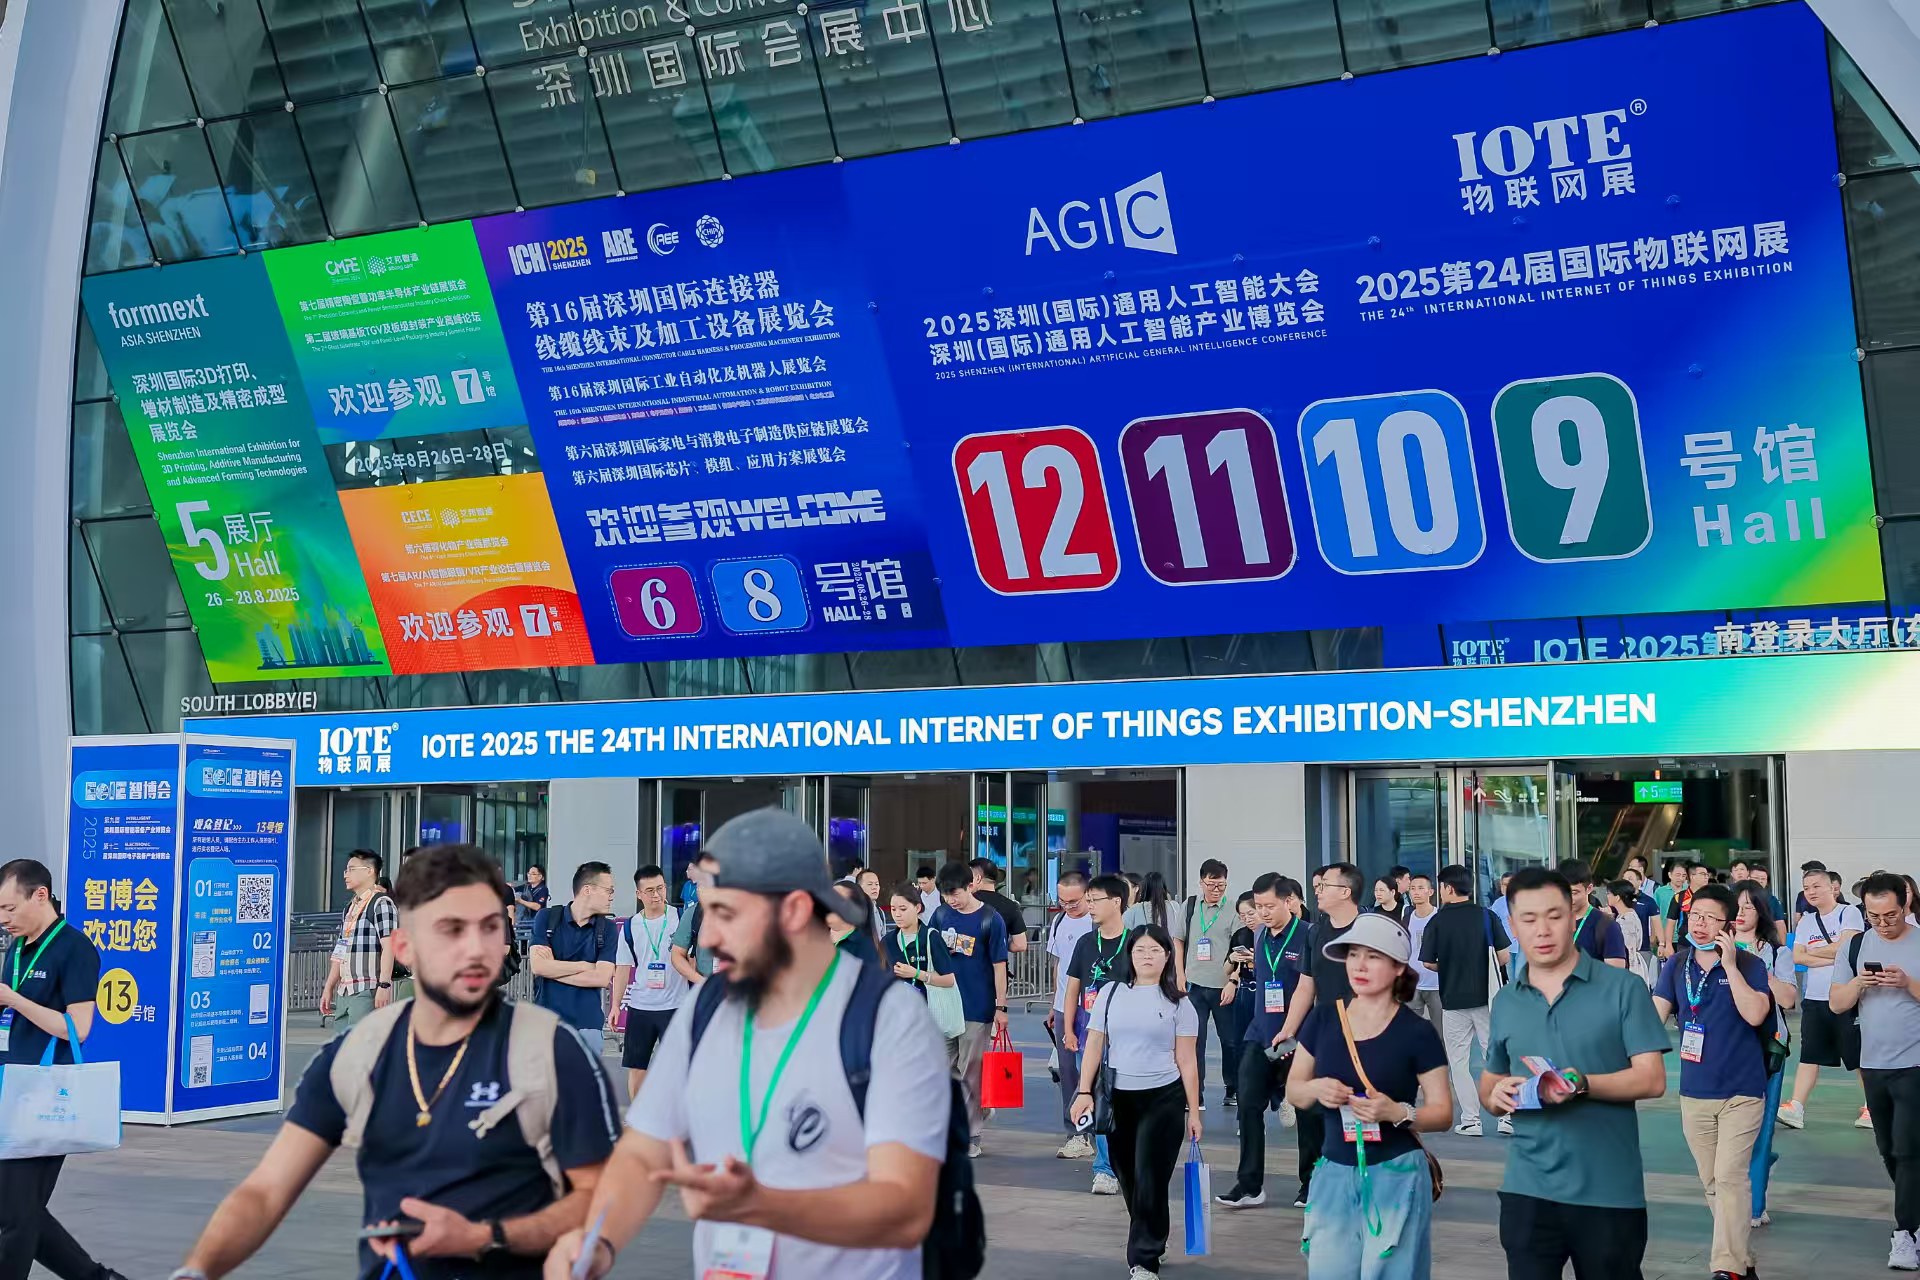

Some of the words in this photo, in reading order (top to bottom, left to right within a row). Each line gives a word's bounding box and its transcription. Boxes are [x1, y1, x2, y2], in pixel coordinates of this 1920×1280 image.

[518, 4, 658, 52] Exhibition
[531, 0, 993, 108] 深圳国际会展中心
[1461, 161, 1636, 216] 物联网展
[1025, 174, 1175, 256] AGIC
[508, 242, 546, 276] ICH
[546, 236, 588, 261] 2025
[601, 228, 638, 257] ARE
[553, 258, 592, 271] SHENZHEN
[1355, 219, 1789, 305] 2025第24届国际物联网展
[525, 269, 781, 330] 第16届深圳国际连接器
[922, 268, 1320, 338] 2025深圳(国际)通用人工智能大会
[1360, 310, 1385, 322] THE
[1390, 306, 1415, 319] 24th
[1424, 293, 1535, 315] INTERNATIONAL
[1541, 283, 1613, 301] INTERNET
[1619, 280, 1636, 291] OF
[1641, 272, 1697, 290] THINGS
[1704, 261, 1793, 283] EXHIBITION
[108, 293, 209, 329] formnext
[121, 333, 146, 348] ASIA
[146, 326, 201, 345] SHENZHEN
[534, 298, 836, 362] 线缆线束及加工设备展览会
[929, 298, 1326, 367] 深圳(国际)通用人工智能产业博览会
[935, 370, 956, 380] 2025
[958, 364, 1006, 377] SHENZHEN
[1008, 356, 1087, 374] (INTERNATIONAL)
[1089, 350, 1140, 364] ARTIFICIAL
[1143, 345, 1186, 357] GENERAL
[1189, 336, 1258, 353] INTELLIGENCE
[1261, 329, 1328, 345] CONFERENCE
[132, 362, 258, 395] 深圳国际3D打印、
[327, 374, 446, 417] 欢迎参观
[458, 372, 473, 400] 7
[548, 355, 827, 402] 第16届深圳国际工业自动化及机器人展览会
[140, 383, 288, 419] 增材制造及精密成型
[149, 420, 198, 443] 展览会
[565, 416, 869, 461] 第六届深圳国际家电与消费电子制造供应链展览会
[157, 449, 195, 461] Shenzhen
[196, 443, 247, 457] International
[248, 440, 287, 452] Exhibition
[288, 439, 300, 448] for
[161, 464, 173, 474] 3D
[209, 457, 241, 469] Additive
[242, 452, 301, 467] Manufacturing
[1680, 423, 1819, 490] 号馆
[166, 475, 181, 487] and
[182, 471, 220, 485] Advanced
[221, 469, 254, 481] Forming
[254, 465, 308, 478] Technologies
[966, 444, 1102, 580] 12
[1143, 428, 1270, 569] 11
[1312, 409, 1459, 558] 10
[1531, 395, 1610, 545] 9
[175, 500, 230, 581] 5
[223, 511, 274, 545] 展厅
[1692, 497, 1827, 548] Hall
[235, 549, 281, 578] Hall
[205, 592, 223, 607] 26
[236, 587, 300, 606] 28.8.2025
[640, 577, 676, 630] 6
[743, 569, 783, 621] 8
[822, 605, 861, 622] HALL
[875, 604, 887, 620] 6
[900, 602, 913, 618] 8
[398, 607, 513, 643] 欢迎参观
[526, 608, 540, 633] 7
[181, 695, 235, 713] SOUTH
[243, 692, 317, 712] LOBBY(E)
[422, 733, 474, 759] IOTE
[480, 731, 538, 757] 2025
[545, 729, 595, 755] THE
[600, 726, 665, 753] 24TH
[674, 718, 890, 750] INTERNATIONAL
[900, 713, 1043, 744] INTERNET
[1052, 711, 1093, 741] OF
[1102, 707, 1222, 739] THINGS
[1233, 693, 1656, 735] EXHIBITION-SHENZHEN
[318, 753, 391, 774] 物联网展
[83, 816, 98, 860] 2025
[193, 818, 233, 831] 观众登记
[256, 821, 284, 834] 13号馆
[83, 877, 158, 911] 智博会
[195, 879, 211, 897] 01
[83, 918, 157, 952] 欢迎您
[252, 932, 272, 950] 02
[102, 980, 132, 1012] 13
[131, 1005, 156, 1023] 号馆
[190, 991, 211, 1009] 03
[248, 1042, 267, 1060] 04
